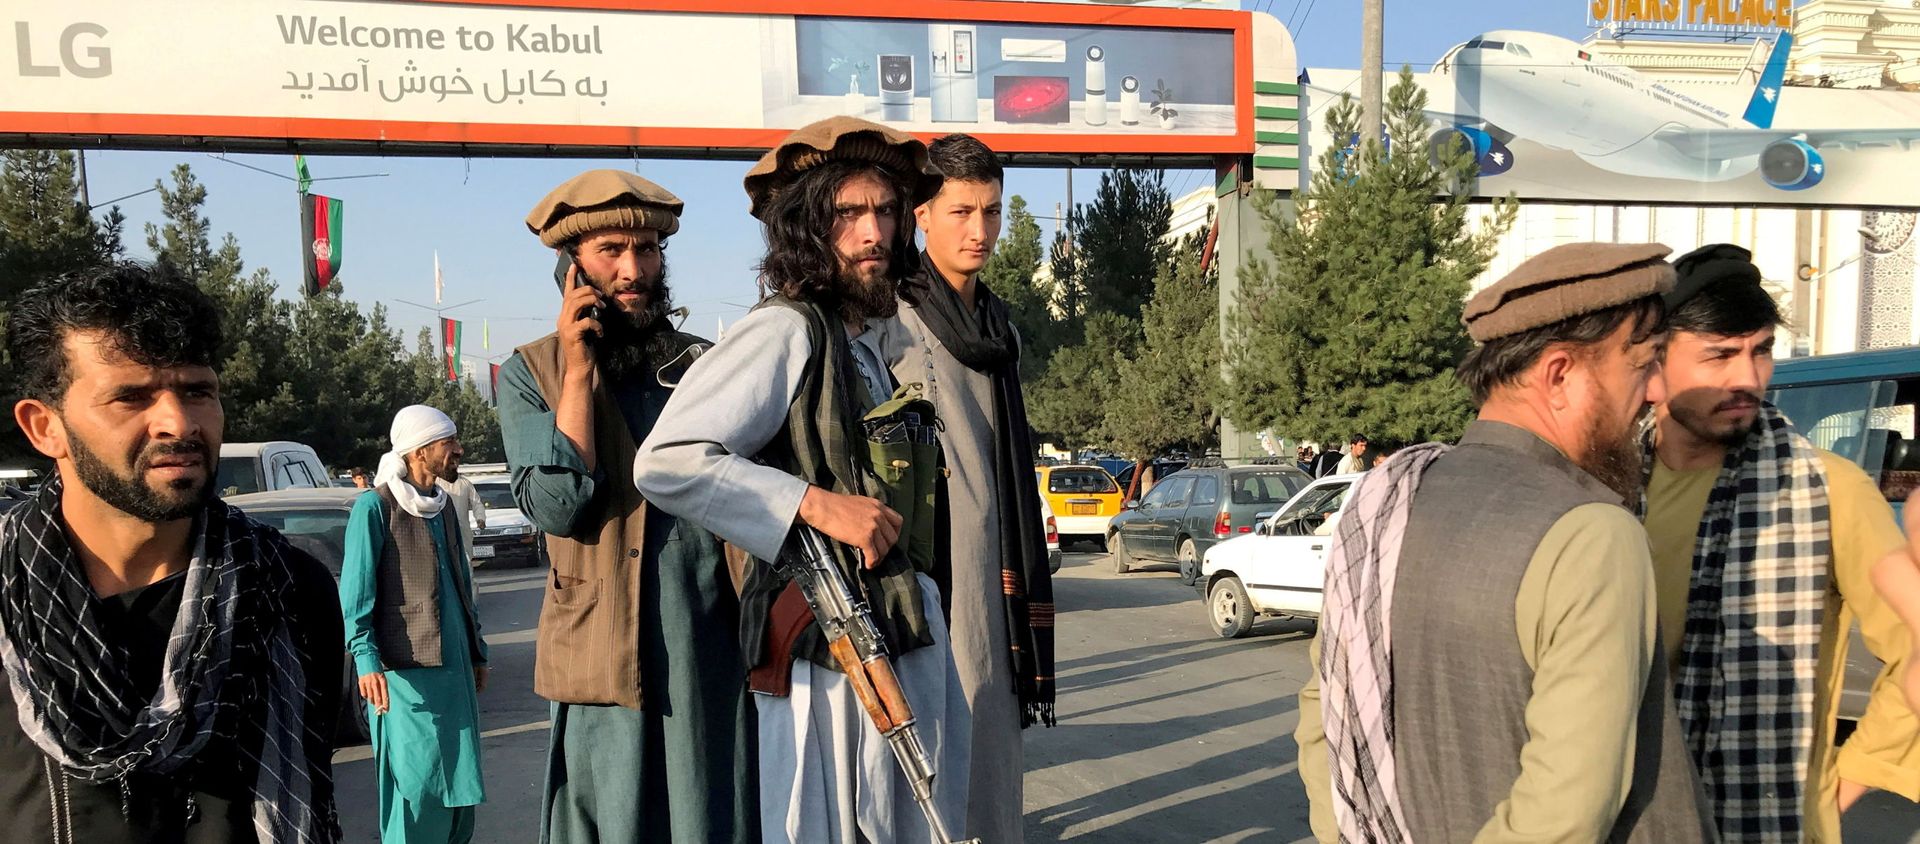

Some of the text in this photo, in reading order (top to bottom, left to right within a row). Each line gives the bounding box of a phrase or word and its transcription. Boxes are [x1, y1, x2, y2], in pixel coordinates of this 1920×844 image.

[15, 21, 112, 79] LG
[276, 14, 603, 55] Welcome to Kabul
[281, 58, 608, 107] به کابل خوش آمدید
